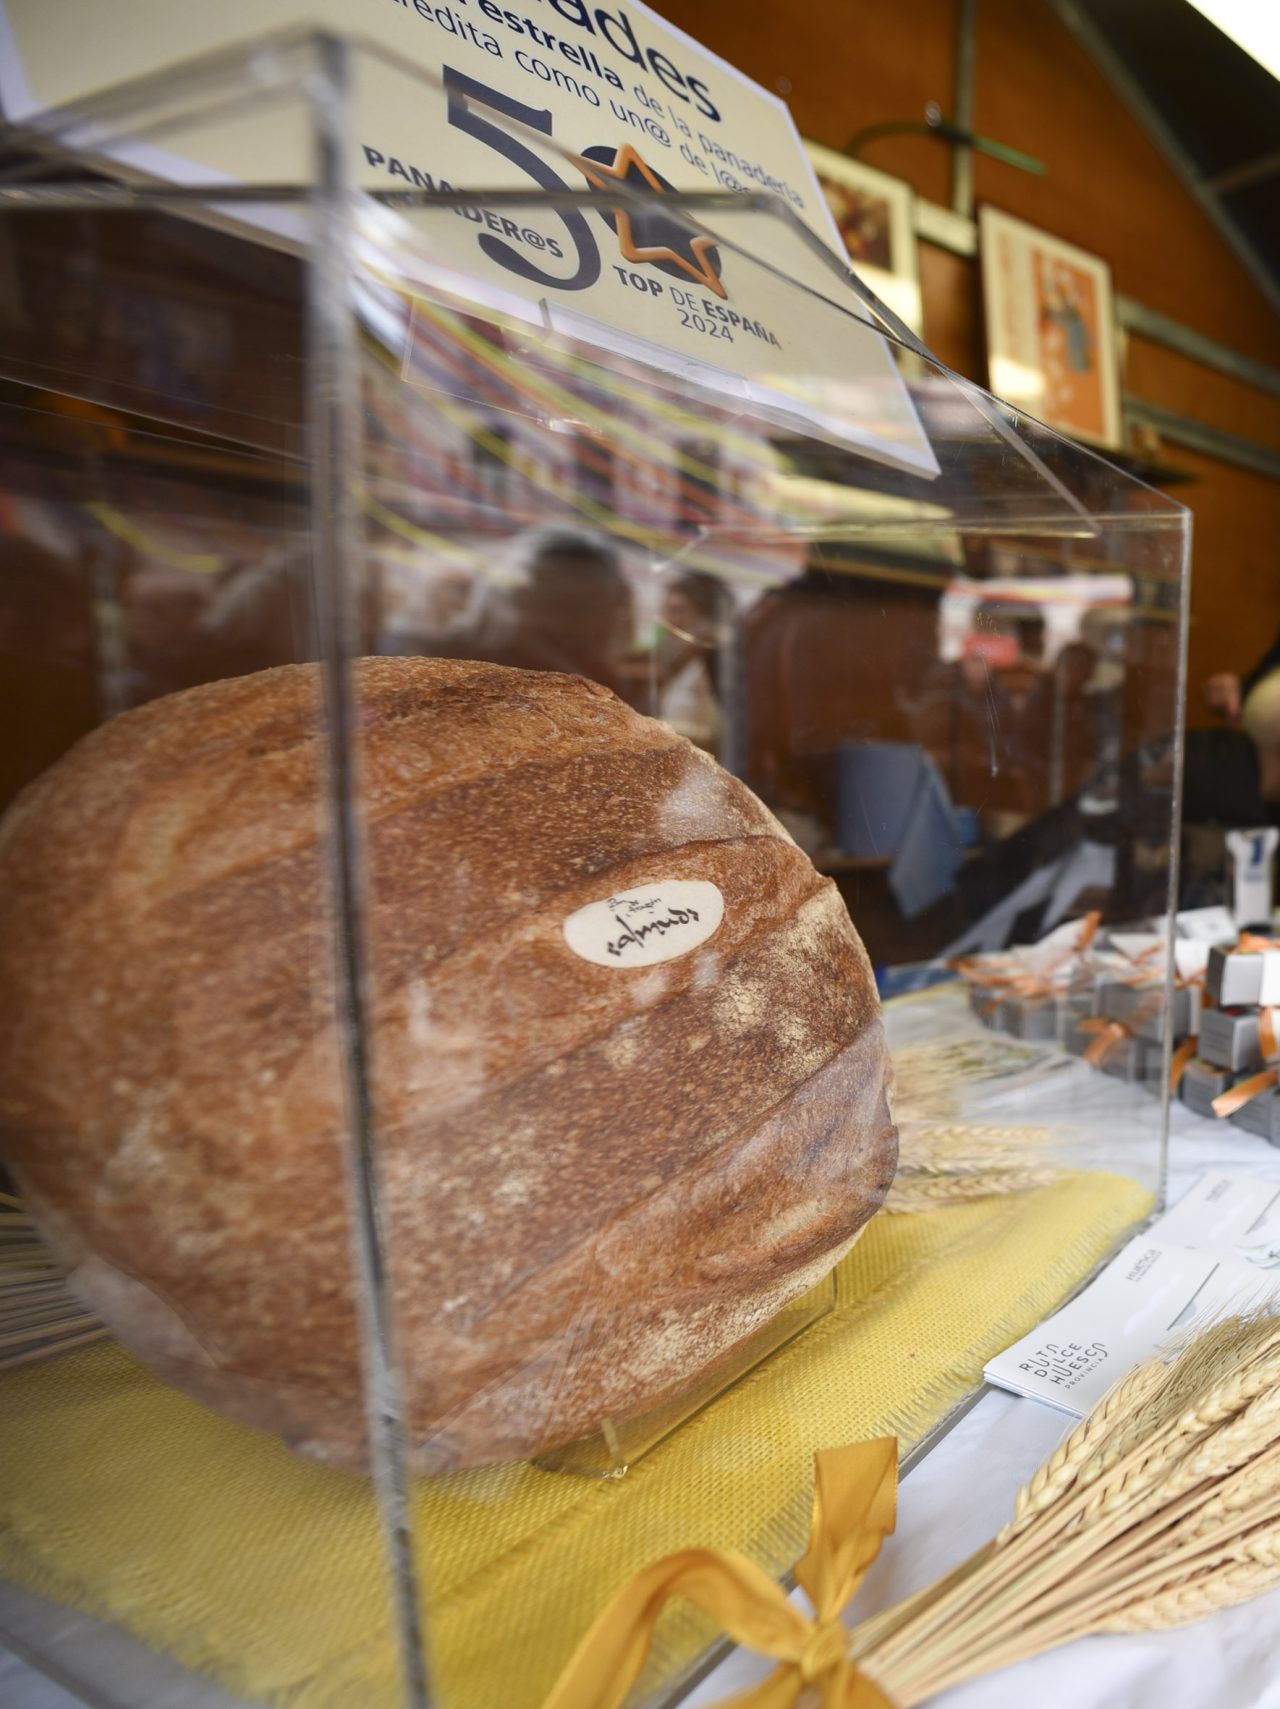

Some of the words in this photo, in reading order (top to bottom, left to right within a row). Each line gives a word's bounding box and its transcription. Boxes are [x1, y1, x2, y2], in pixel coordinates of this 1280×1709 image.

[393, 0, 503, 58] edita
[514, 50, 600, 107] como
[610, 99, 672, 147] un@
[680, 143, 708, 175] de
[478, 0, 624, 91] estrella
[633, 85, 665, 118] de
[668, 105, 692, 138] la
[544, 0, 721, 122] ades
[612, 264, 663, 297] TOP
[669, 286, 700, 313] DE
[701, 298, 783, 350] ESPAÑA
[676, 308, 734, 343] 2024
[1049, 1342, 1109, 1385] HUESCA
